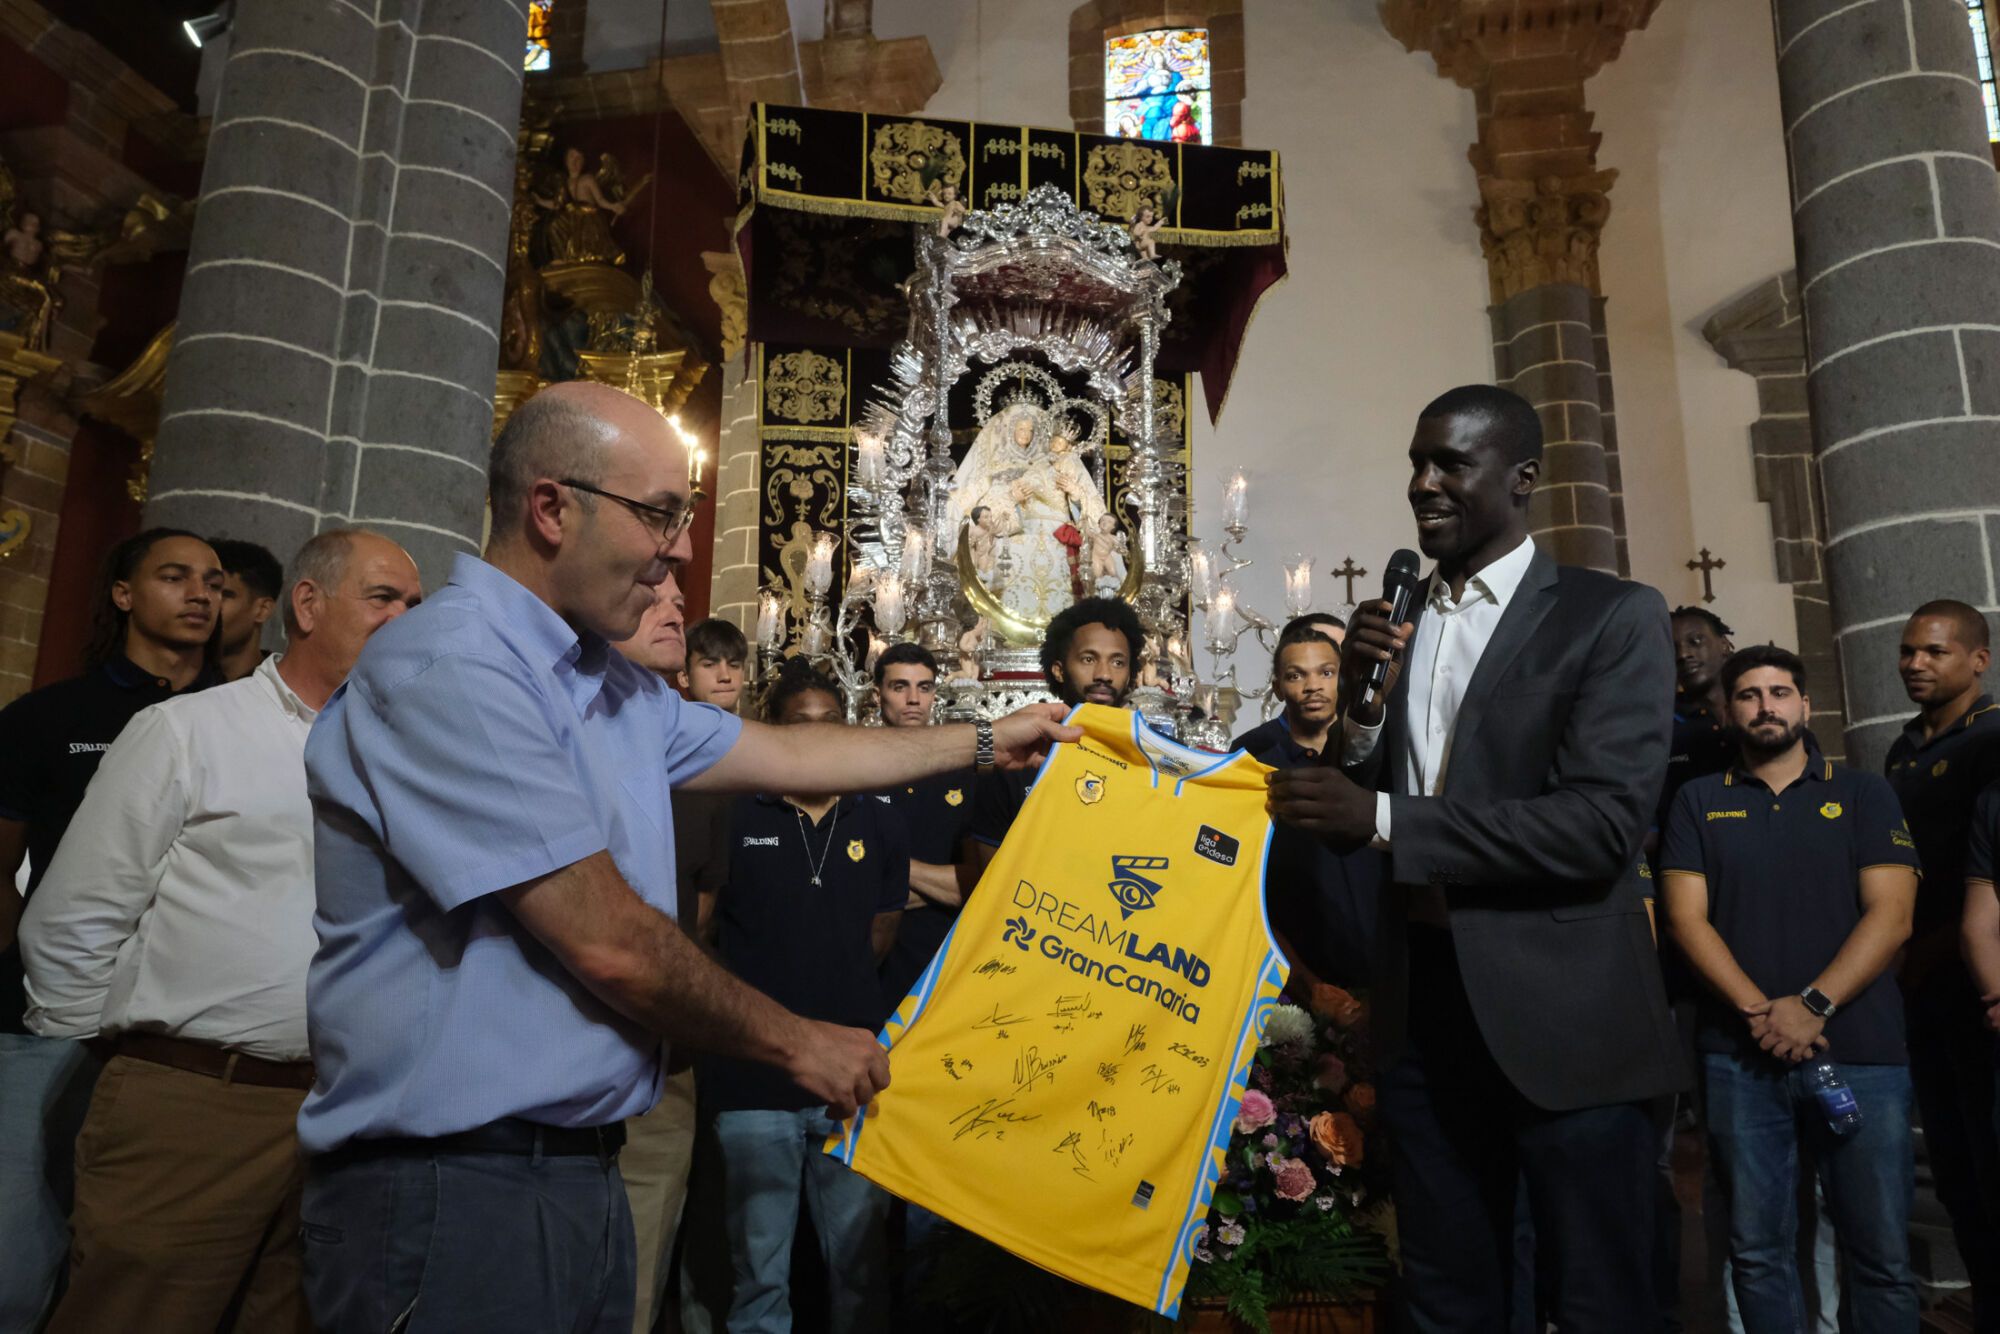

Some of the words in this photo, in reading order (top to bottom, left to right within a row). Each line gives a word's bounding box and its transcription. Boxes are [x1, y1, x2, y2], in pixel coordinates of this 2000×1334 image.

[69, 742, 110, 754] SPALDI
[1706, 810, 1748, 822] SPALDING
[743, 836, 779, 848] SPALDING
[1200, 834, 1217, 848] liga
[1198, 843, 1233, 863] endesa
[1012, 879, 1211, 988] DREAMLAND
[1039, 934, 1200, 1025] GranCanaria
